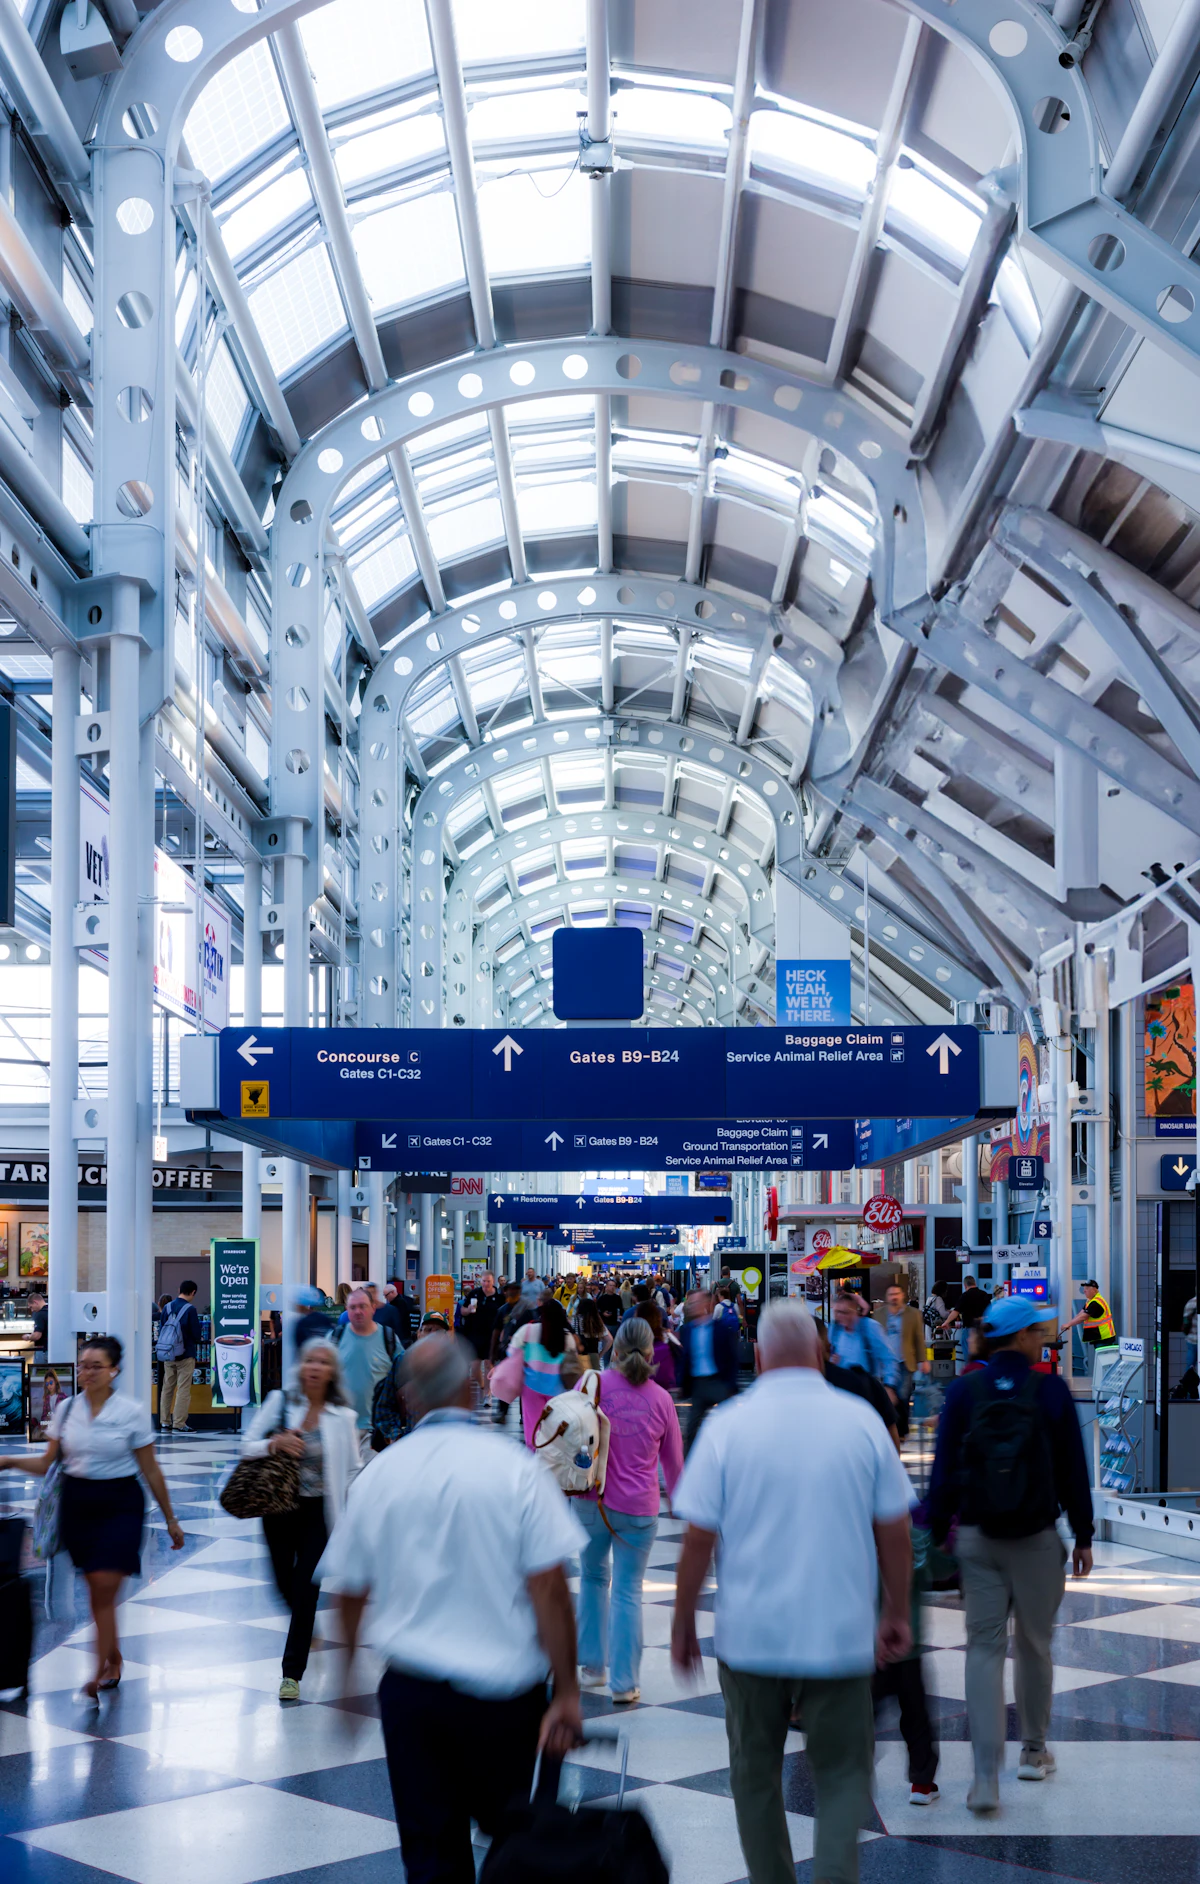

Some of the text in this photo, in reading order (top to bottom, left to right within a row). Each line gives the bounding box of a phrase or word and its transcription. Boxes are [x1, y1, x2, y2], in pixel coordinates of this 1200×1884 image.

[85, 840, 103, 887] VET
[785, 969, 827, 982] HECK
[785, 983, 831, 997] YEAH,
[785, 996, 833, 1009] WE FLY
[785, 1009, 835, 1022] THERE.
[785, 1034, 883, 1047] Baggage Claim
[316, 1050, 419, 1063] Concourse C
[569, 1050, 680, 1063] Gates B9-B24
[726, 1050, 883, 1062] Service Animal Relief Area
[339, 1068, 421, 1079] Gates C1-C32
[1159, 1122, 1184, 1130] DINOSAUR
[717, 1127, 788, 1139] Baggage Claim
[423, 1136, 451, 1146] Gates
[588, 1136, 617, 1146] Gates
[682, 1141, 788, 1153] Ground Transportation
[665, 1155, 788, 1165] Service Animal Relief Area
[153, 1171, 213, 1188] OFFEE
[452, 1178, 483, 1195] CNN
[871, 1194, 894, 1202] CHICAGO
[868, 1223, 897, 1233] CHEESECAKE
[1010, 1249, 1034, 1257] Seaway
[220, 1264, 249, 1274] We're
[220, 1275, 248, 1287] Open
[1124, 1342, 1142, 1352] CHICAGO
